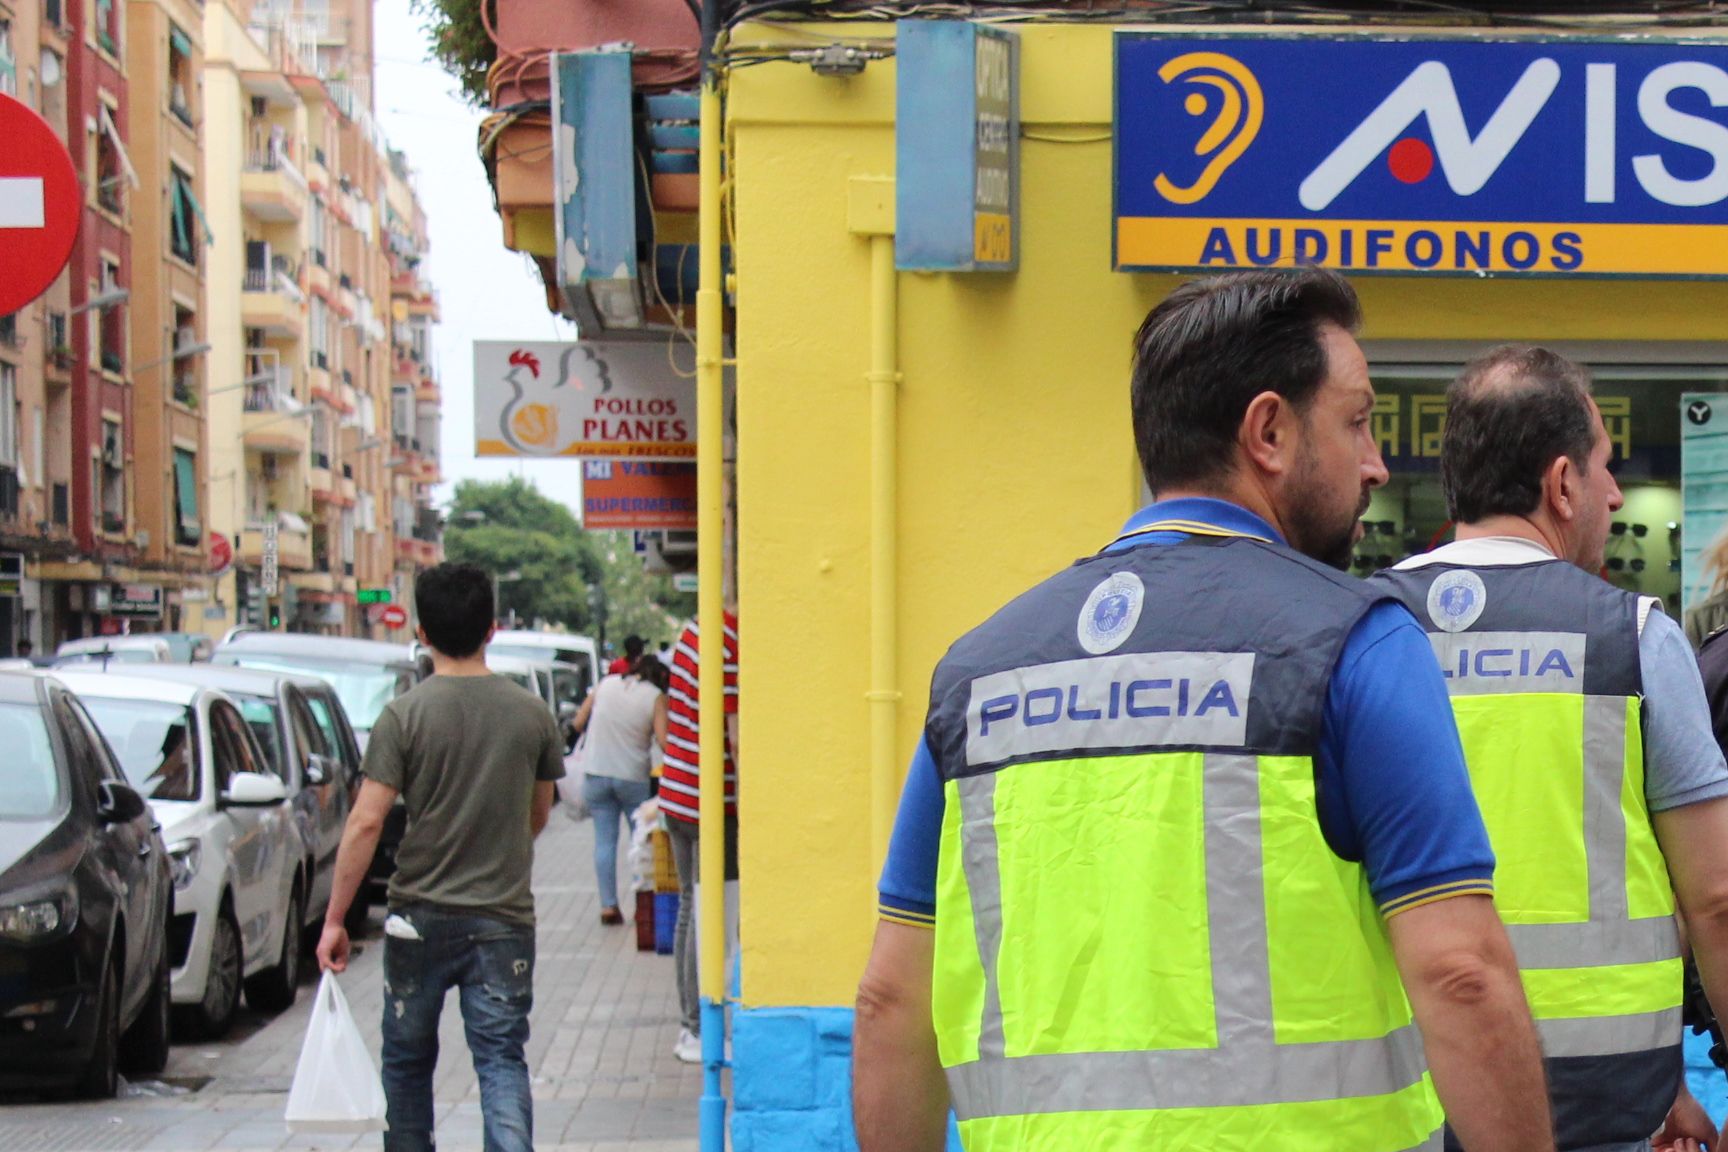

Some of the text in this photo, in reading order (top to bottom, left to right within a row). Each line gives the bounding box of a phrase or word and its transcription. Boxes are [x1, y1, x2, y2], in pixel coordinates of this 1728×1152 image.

[1198, 226, 1585, 271] AUDIFONOS
[593, 398, 677, 416] POLLOS
[582, 419, 688, 442] PLANES
[1443, 648, 1575, 679] ICIA
[979, 678, 1240, 738] POLICIA
